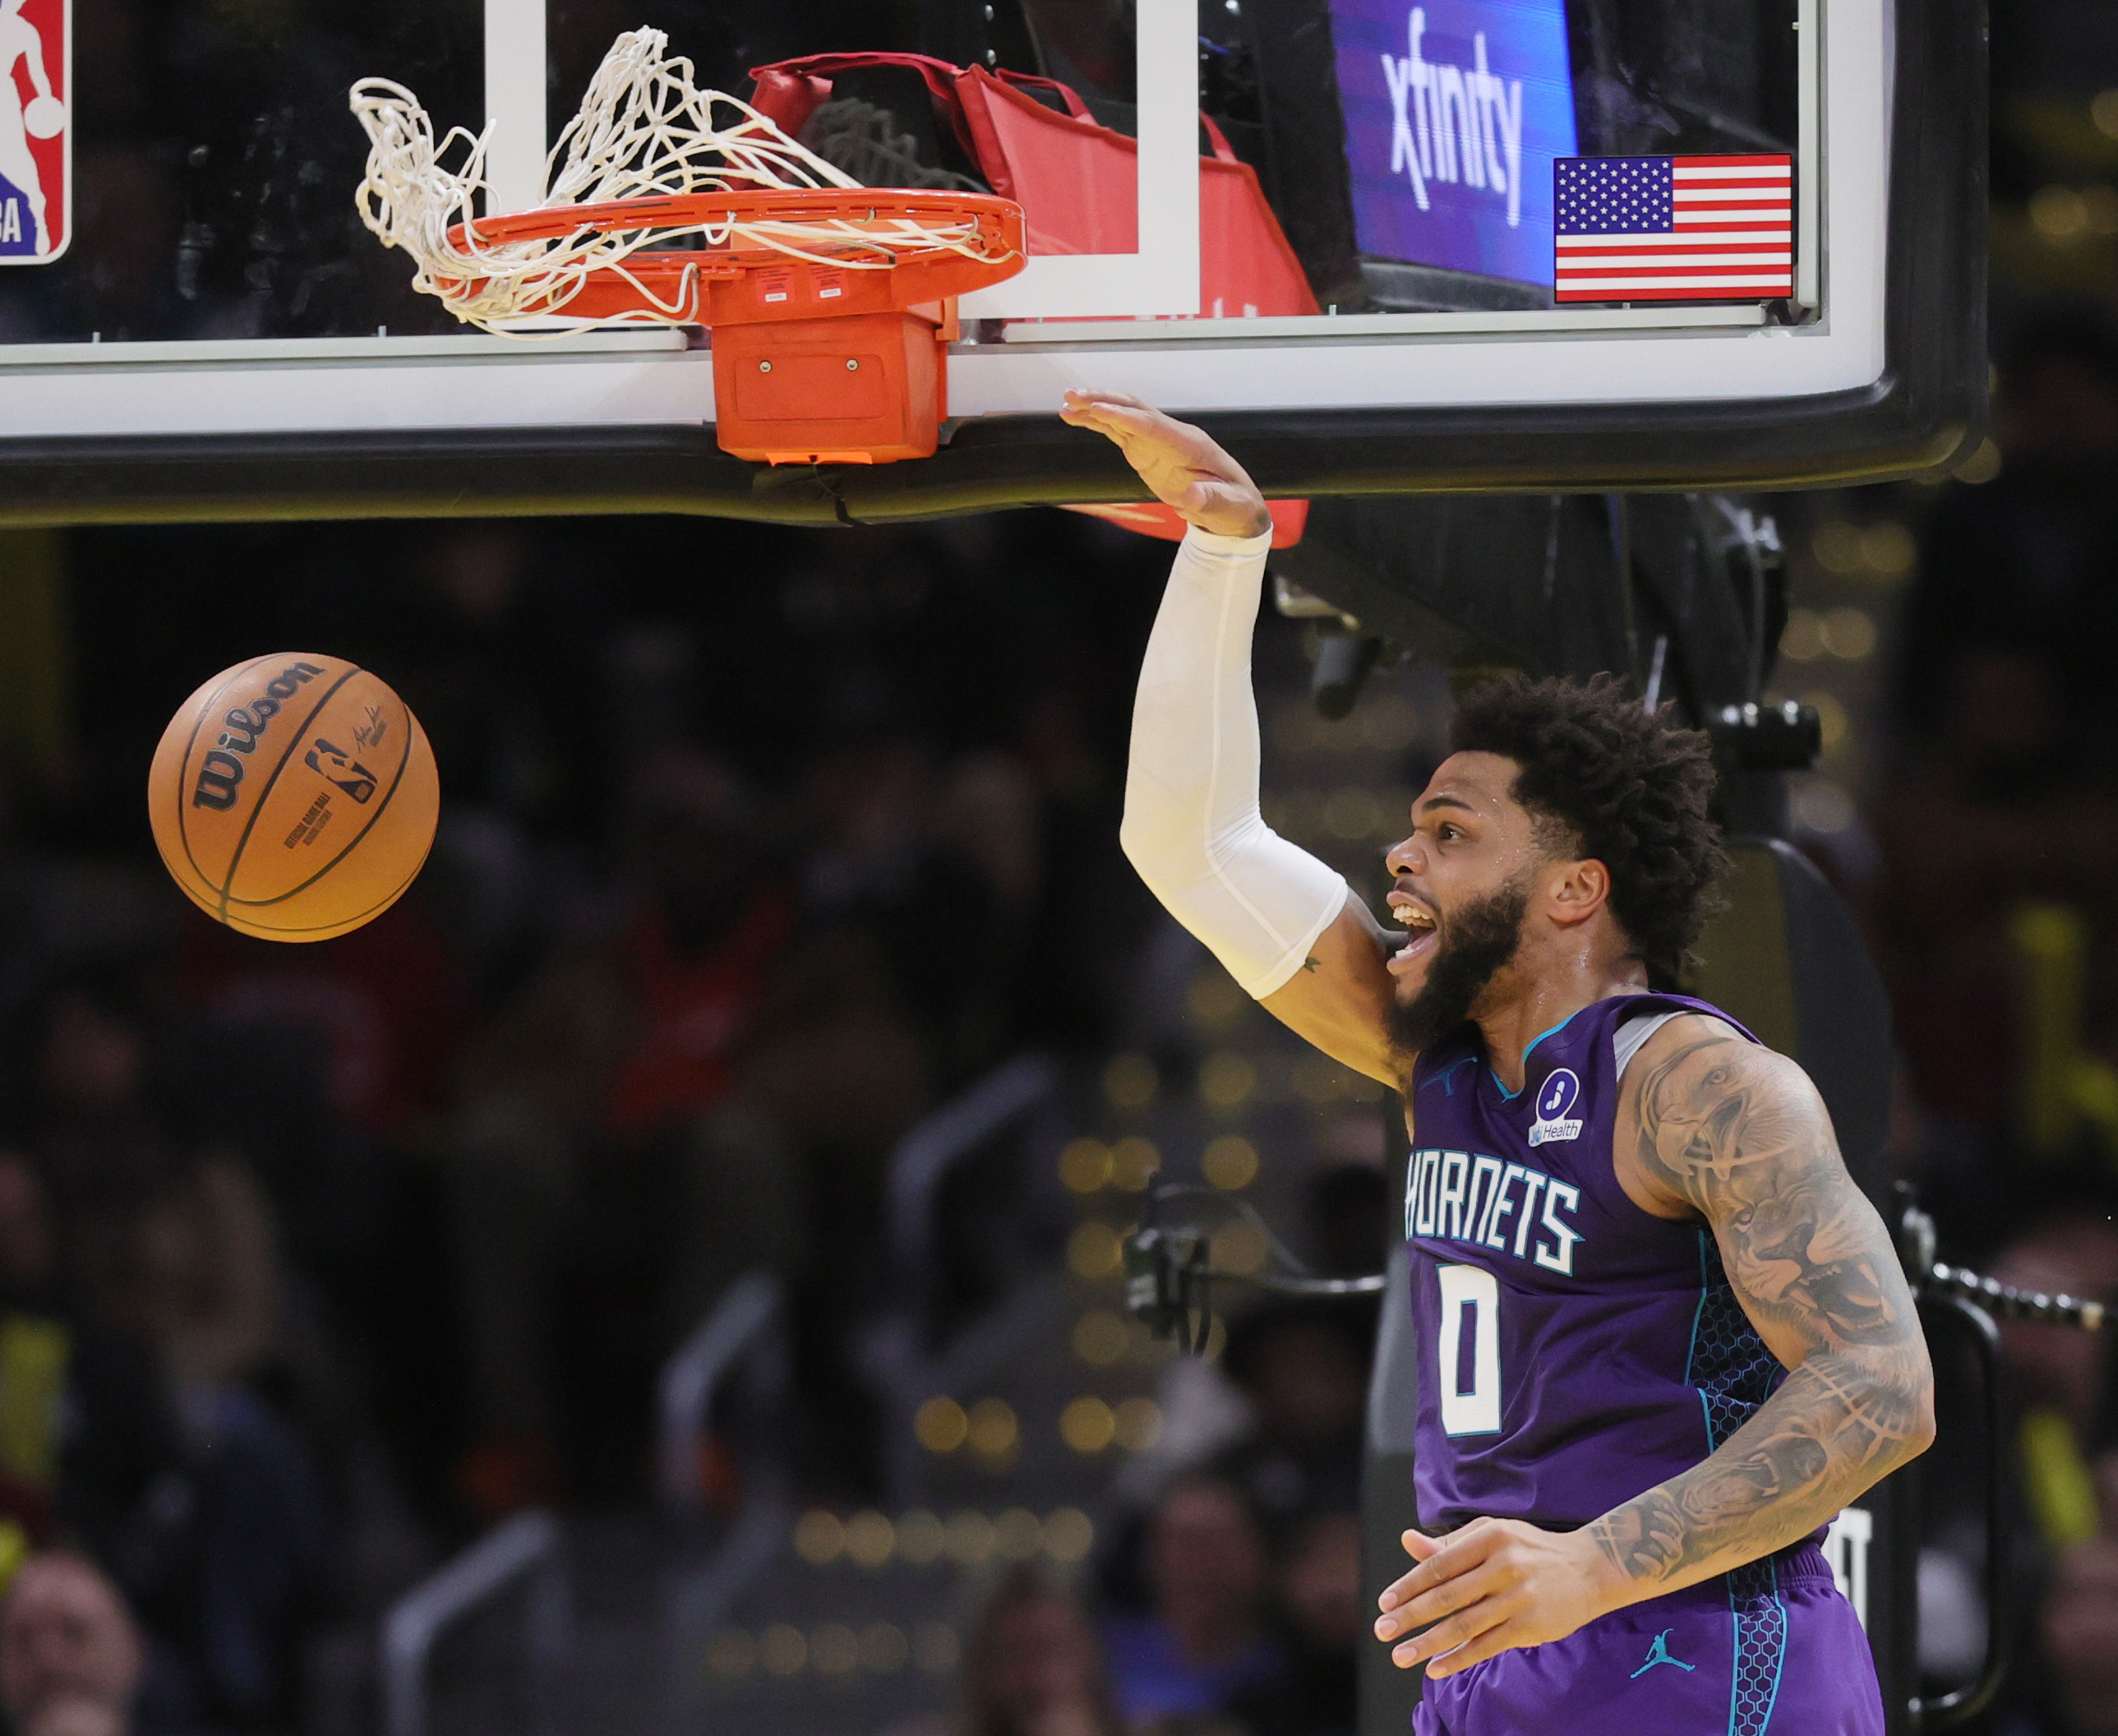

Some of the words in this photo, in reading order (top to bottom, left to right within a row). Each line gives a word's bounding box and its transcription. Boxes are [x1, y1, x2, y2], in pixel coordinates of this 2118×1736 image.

[1381, 7, 1521, 228] xfinity
[193, 662, 325, 811] Wilson
[1544, 1121, 1578, 1139] Health
[1405, 1149, 1585, 1277] HORNETS
[1436, 1263, 1502, 1437] 0
